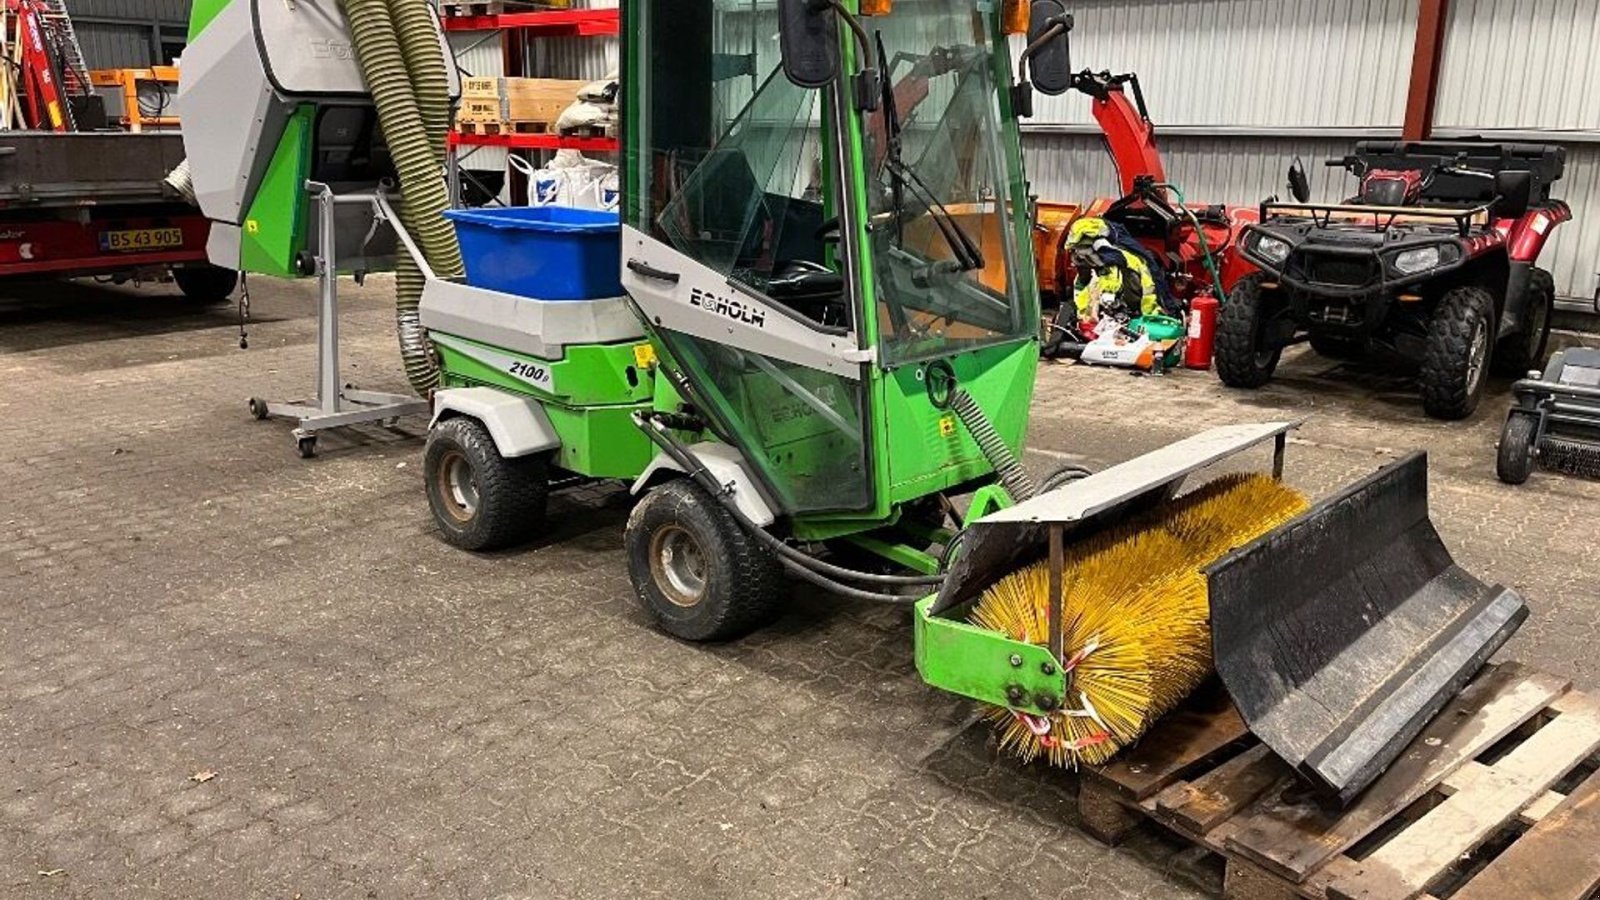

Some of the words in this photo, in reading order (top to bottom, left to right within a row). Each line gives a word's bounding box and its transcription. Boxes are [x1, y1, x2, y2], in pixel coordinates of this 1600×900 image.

[111, 233, 131, 246] BS
[134, 231, 152, 245] 43
[154, 230, 181, 244] 905
[690, 287, 765, 328] EGHOLM
[509, 361, 545, 380] 2100
